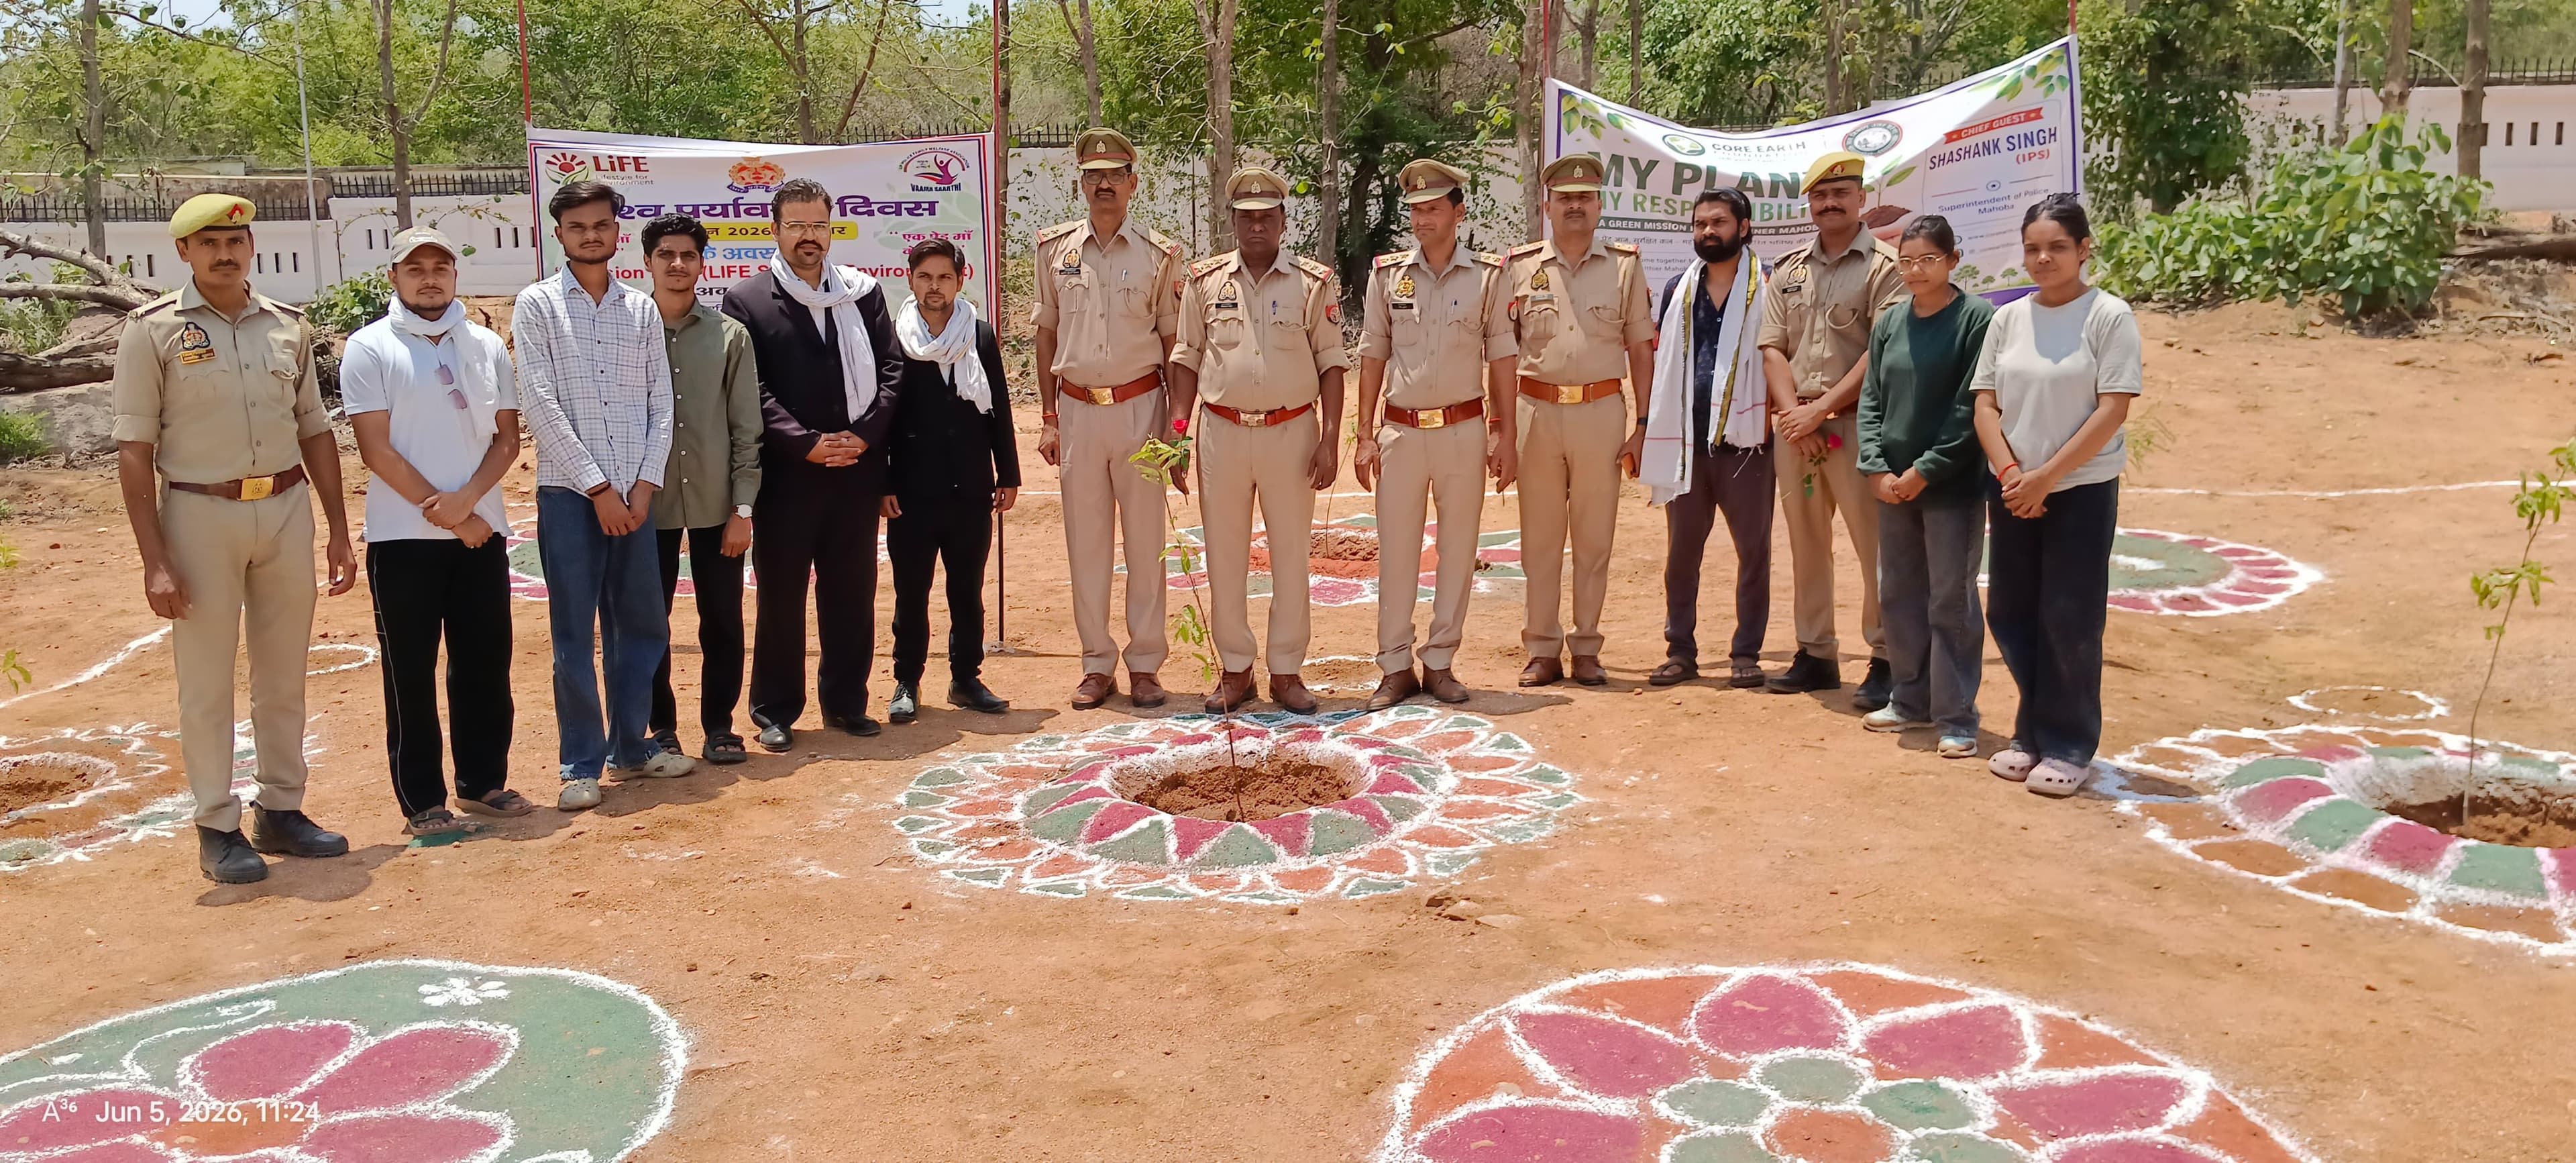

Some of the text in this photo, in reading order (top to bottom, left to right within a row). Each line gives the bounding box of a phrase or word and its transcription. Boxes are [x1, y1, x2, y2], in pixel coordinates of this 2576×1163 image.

[1961, 112, 2027, 138] CHIEF GUEST
[1711, 143, 1752, 153] CORE
[1929, 138, 2002, 170] SHASHANK
[2006, 126, 2057, 152] SINGH
[2016, 148, 2051, 165] (IPS)
[592, 154, 649, 173] LiFE
[1670, 160, 1809, 200] PLAN
[835, 195, 940, 217] दिवस
[1937, 188, 2049, 213] Superintendent of Police
[1978, 203, 2015, 215] Mahoba
[1598, 219, 1606, 227] A
[1608, 219, 1642, 229] GREEN
[1644, 222, 1687, 232] MISSION
[1778, 224, 1821, 235] MAHOB
[702, 264, 751, 282] (LIFE
